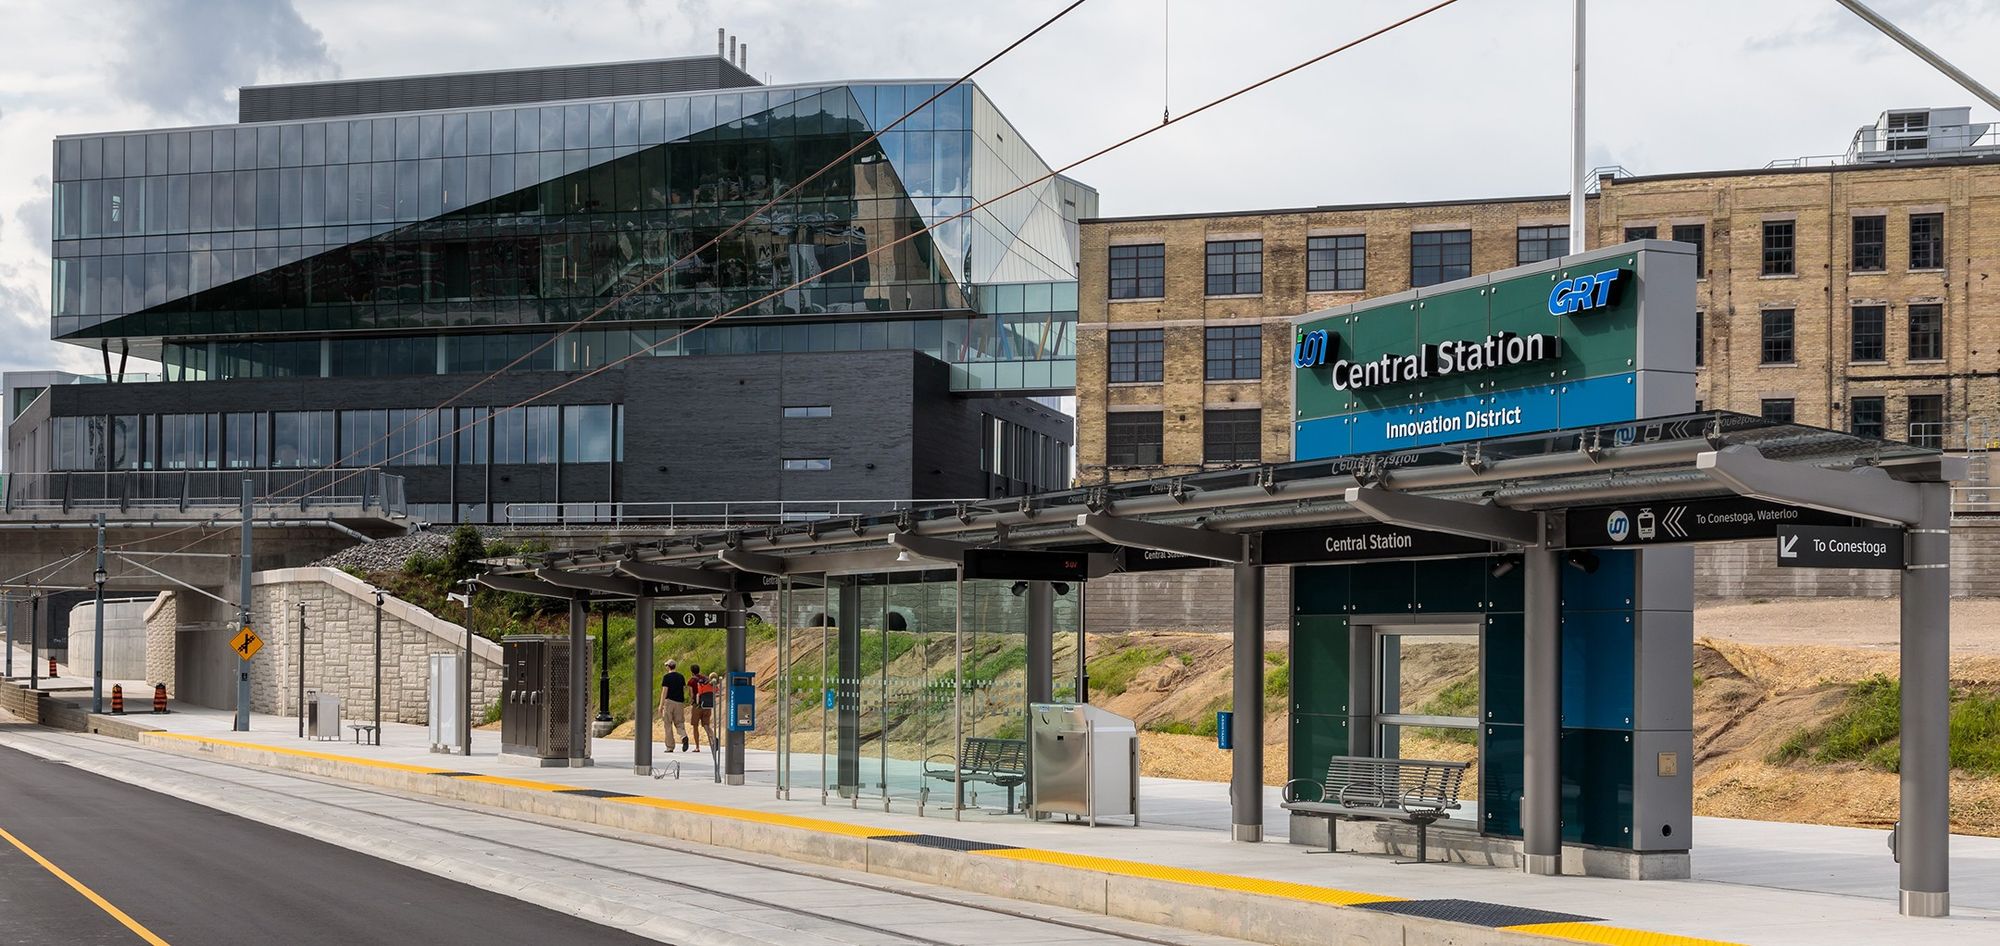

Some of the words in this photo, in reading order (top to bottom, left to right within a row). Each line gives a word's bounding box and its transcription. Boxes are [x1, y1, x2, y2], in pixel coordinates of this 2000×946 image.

[1548, 268, 1619, 316] GRT
[1332, 343, 1428, 391] Central
[1438, 330, 1543, 374] Station
[1386, 414, 1461, 439] Innovation
[1465, 406, 1522, 429] District
[1696, 514, 1706, 524] To
[1707, 512, 1755, 524] Conestoga,
[1757, 508, 1798, 520] Waterloo
[1325, 535, 1366, 552] Central
[1370, 532, 1412, 549] Station
[1813, 539, 1826, 552] To
[1828, 540, 1887, 556] Conestoga
